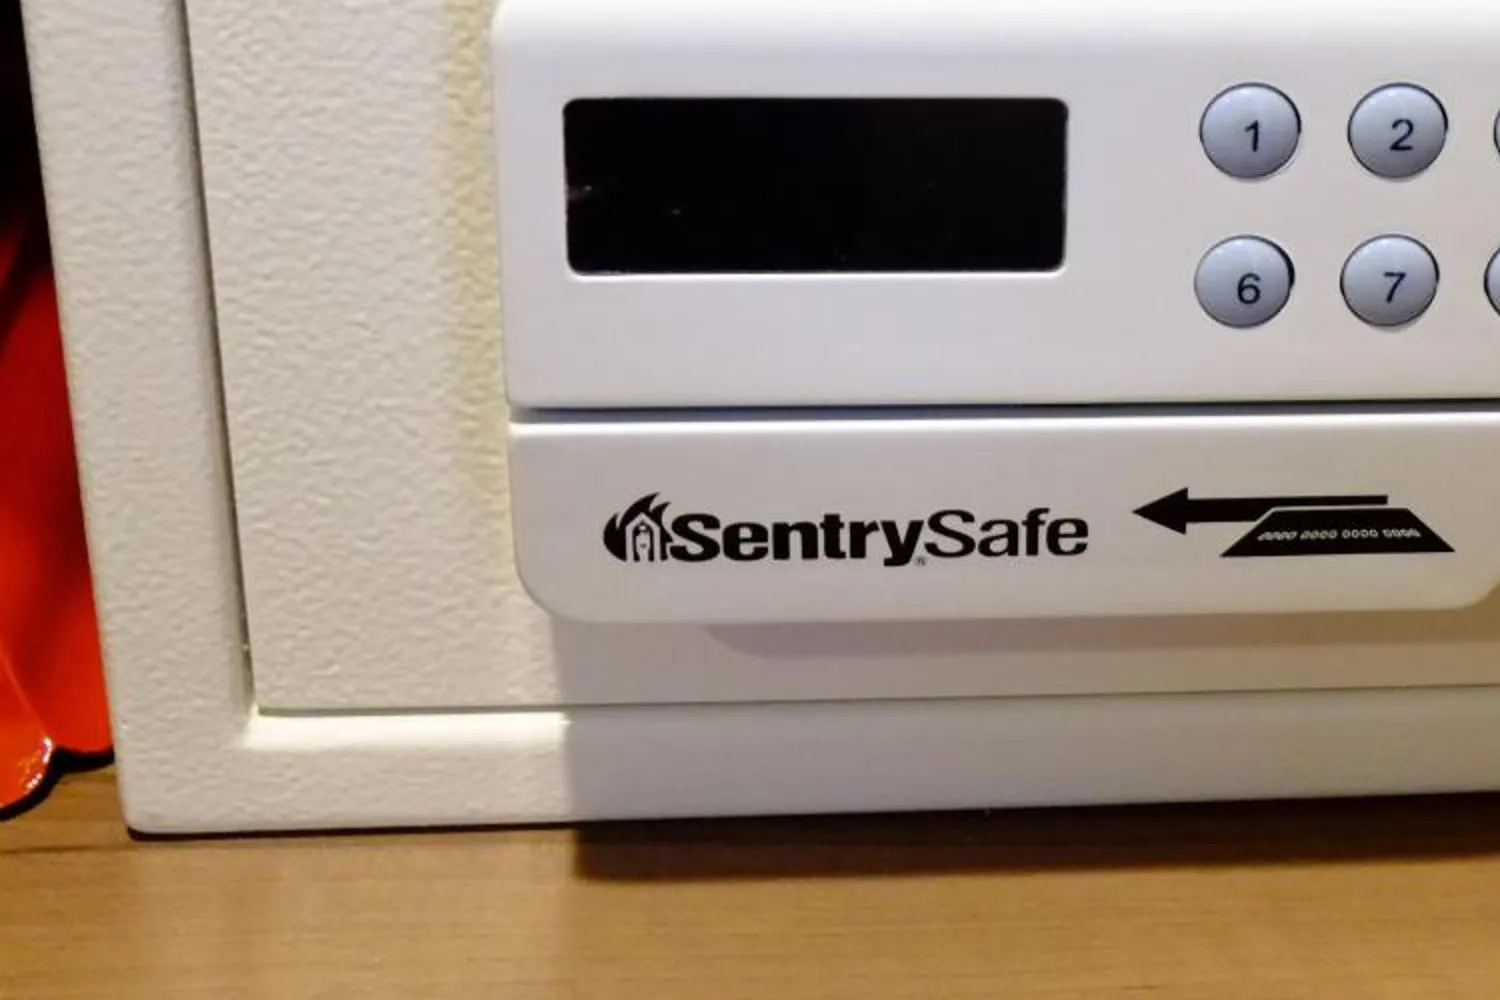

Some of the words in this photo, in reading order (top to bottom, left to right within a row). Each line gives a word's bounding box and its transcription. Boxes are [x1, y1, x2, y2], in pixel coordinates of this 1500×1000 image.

[1244, 120, 1261, 151] 1
[1390, 119, 1414, 151] 2
[1236, 274, 1261, 305] 6
[1383, 272, 1406, 302] 7
[670, 507, 1089, 567] SentrySafe
